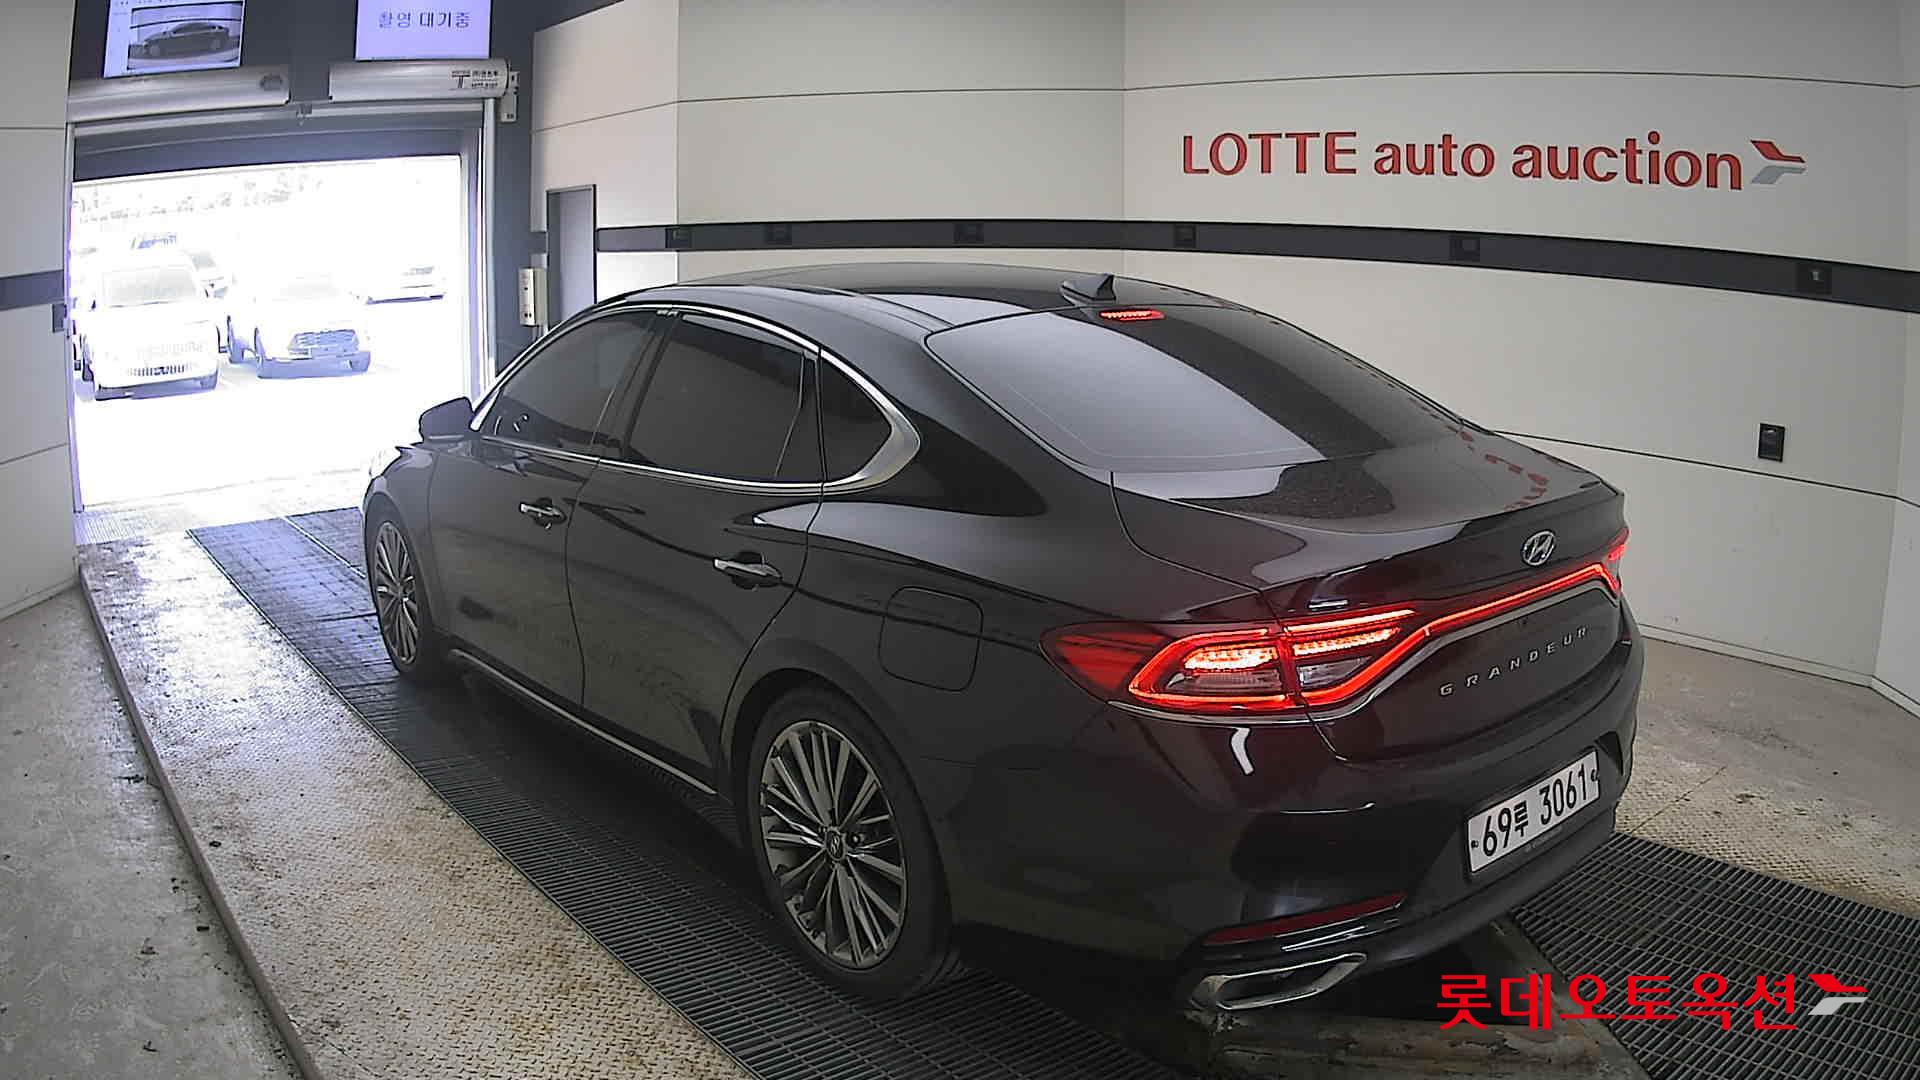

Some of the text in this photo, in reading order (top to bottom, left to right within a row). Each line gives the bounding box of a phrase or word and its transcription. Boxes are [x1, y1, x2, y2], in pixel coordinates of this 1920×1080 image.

[419, 11, 469, 28] 대기중
[1183, 130, 1742, 190] LOTTE auto auction
[1440, 627, 1587, 696] GRANDEUR
[1483, 800, 1529, 857] 69루
[1539, 764, 1587, 825] 3061
